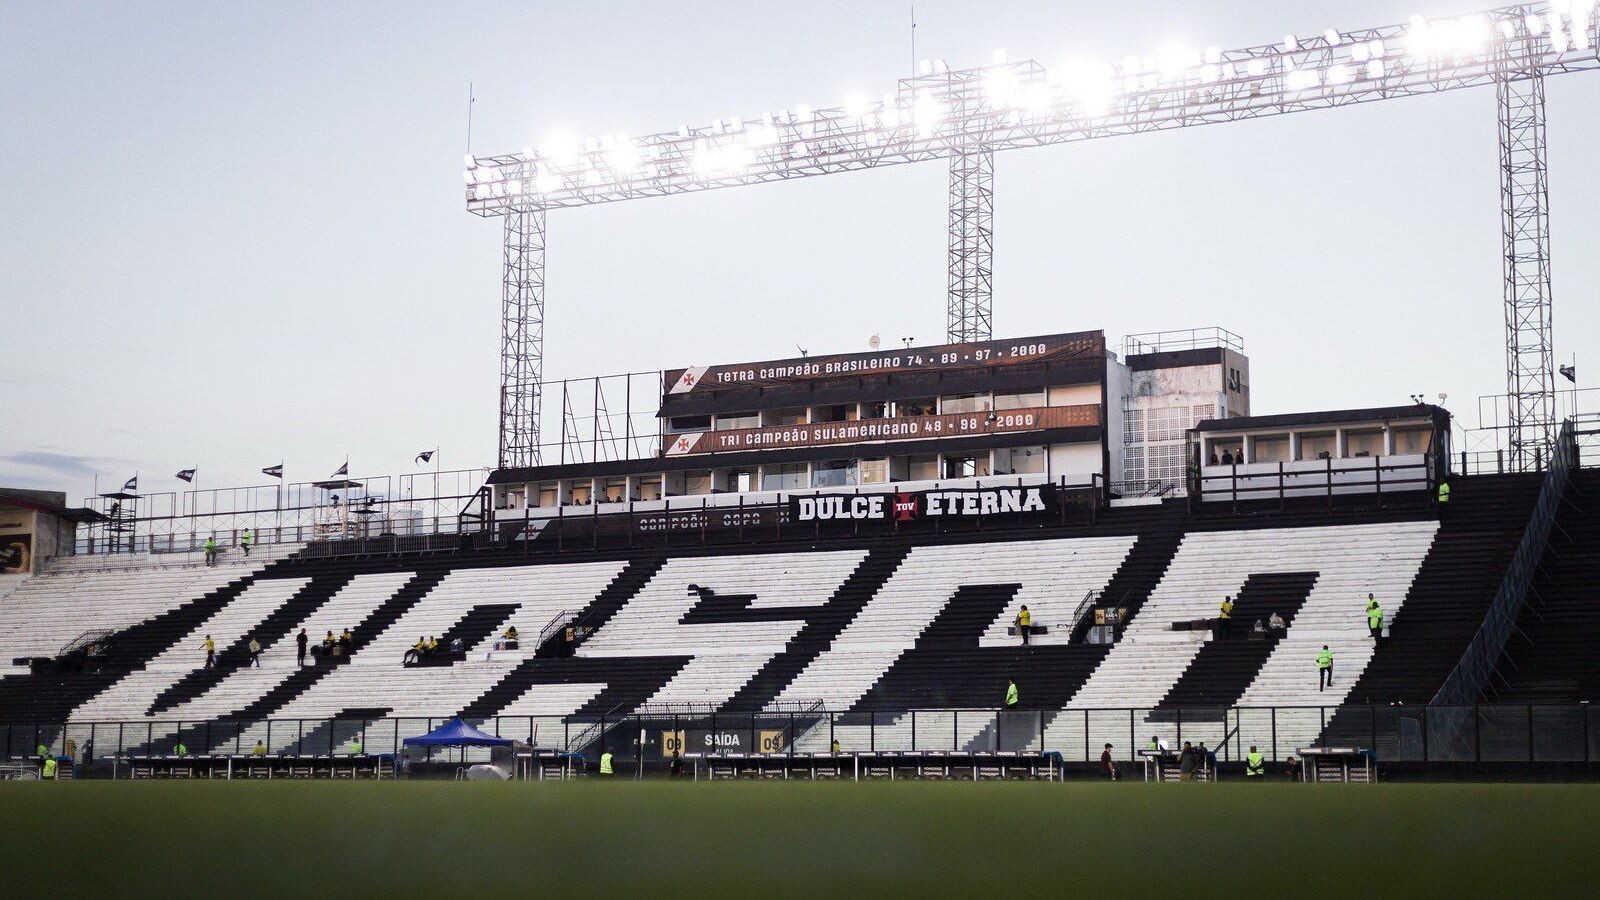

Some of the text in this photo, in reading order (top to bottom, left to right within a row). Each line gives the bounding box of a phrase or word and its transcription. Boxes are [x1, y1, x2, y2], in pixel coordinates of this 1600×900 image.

[908, 355, 922, 366] 74
[941, 353, 957, 364] 89
[975, 349, 990, 360] 97
[1010, 344, 1046, 357] 2000
[720, 434, 739, 447] TRI
[924, 420, 941, 432] 48
[960, 418, 977, 430] 98
[996, 414, 1033, 428] 2000
[799, 496, 884, 520] DULCE
[896, 502, 915, 512] TOV
[926, 488, 1046, 516] ETERNA
[705, 732, 740, 746] SAÍDA
